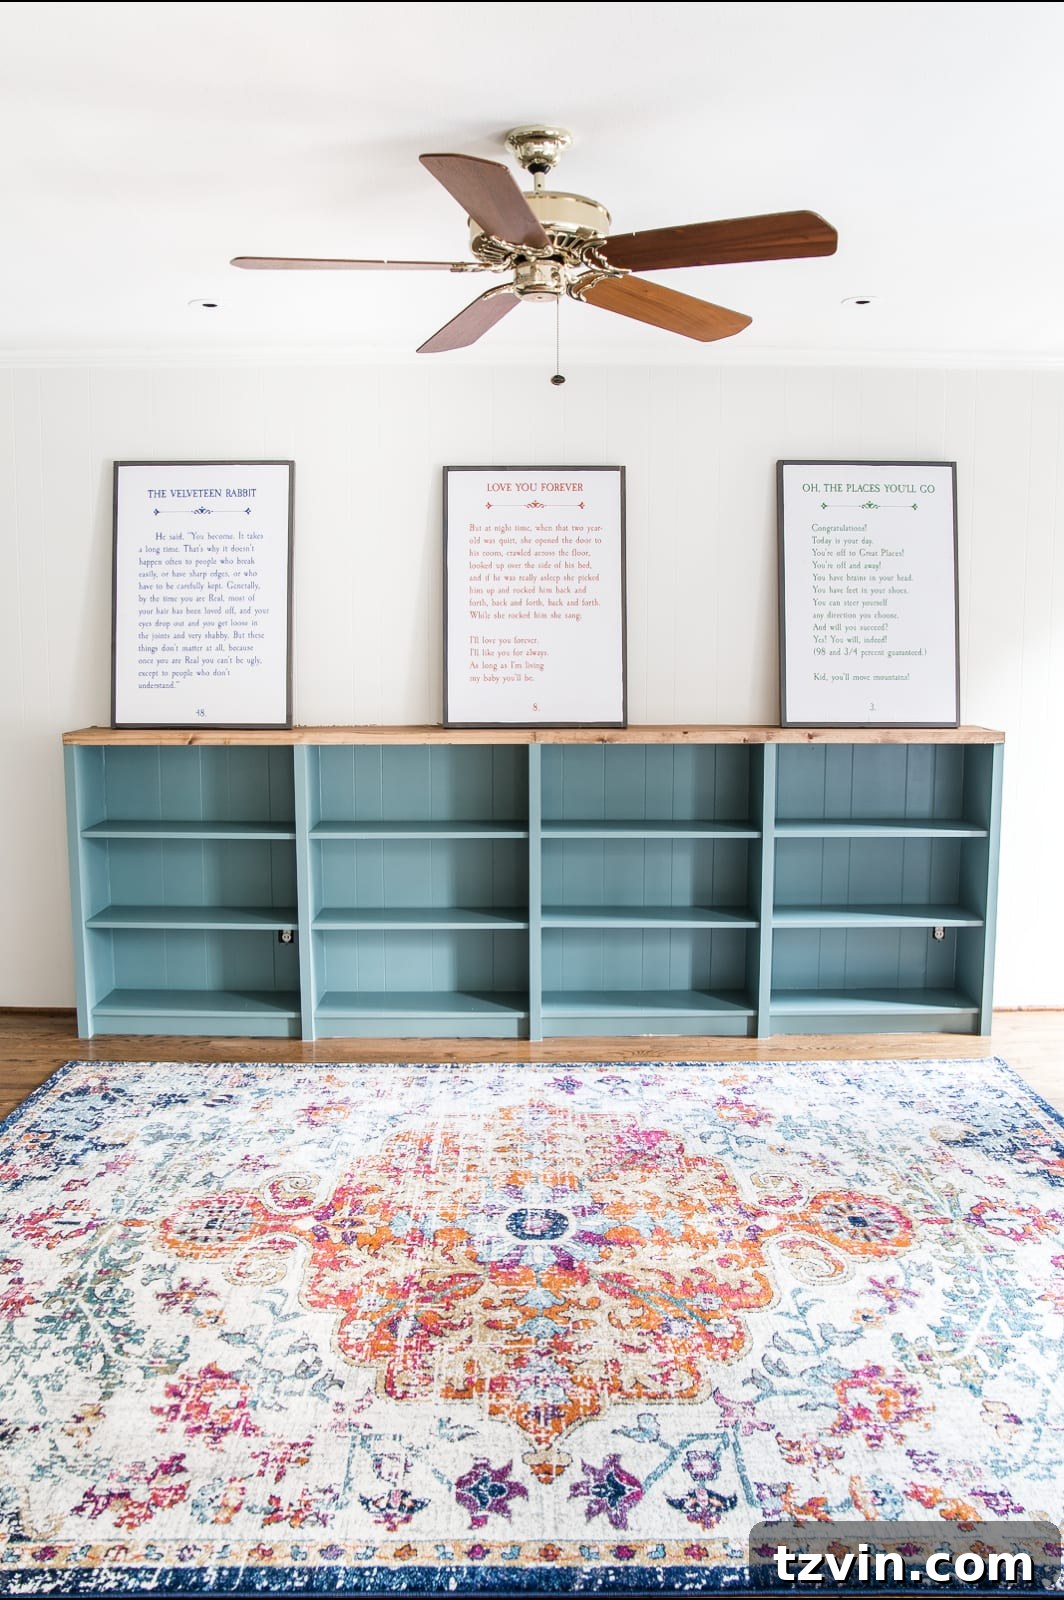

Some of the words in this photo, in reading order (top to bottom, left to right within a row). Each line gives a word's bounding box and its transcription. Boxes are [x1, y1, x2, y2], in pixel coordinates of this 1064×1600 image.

[487, 483, 512, 492] LOVE
[515, 482, 537, 492] YOU
[541, 482, 583, 492] FOREVER
[823, 483, 843, 492] THE
[846, 483, 880, 493] PLACES
[884, 484, 917, 493] YOU'LL
[919, 484, 935, 494] GO
[147, 489, 167, 499] THE
[170, 489, 222, 498] VELVETEEN
[225, 488, 256, 498] RABBIT
